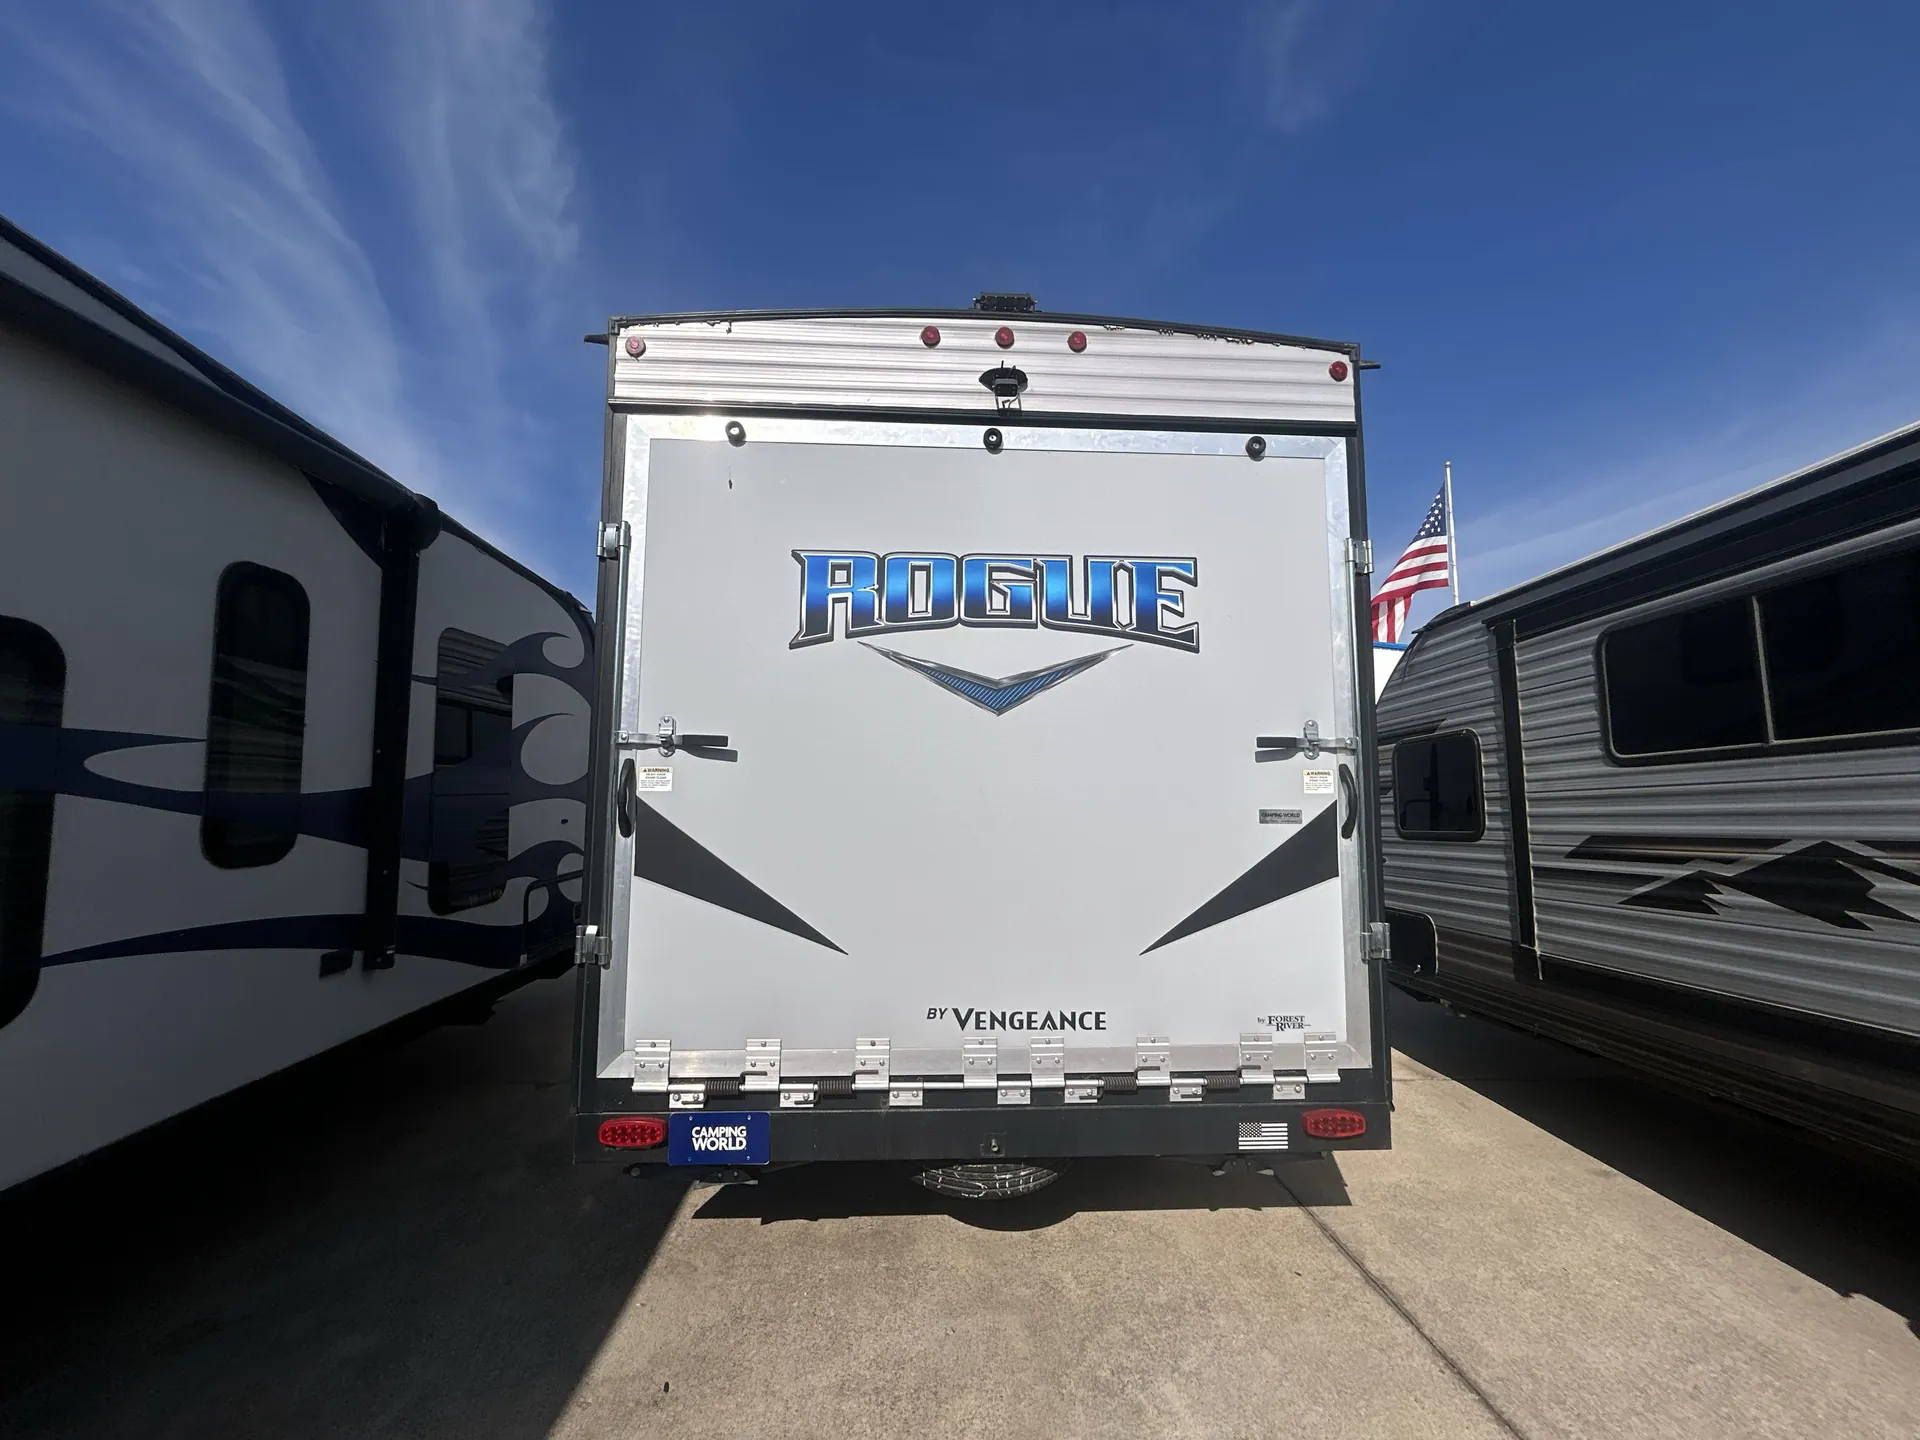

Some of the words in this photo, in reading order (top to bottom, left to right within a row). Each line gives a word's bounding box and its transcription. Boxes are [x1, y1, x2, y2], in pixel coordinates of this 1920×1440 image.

[789, 549, 1200, 653] ROGUE
[927, 1008, 948, 1020] BY
[952, 1008, 1107, 1031] VENGEANCE
[1268, 1015, 1305, 1025] FOREST
[1276, 1022, 1304, 1031] RIVER
[691, 1126, 747, 1138] CAMPING
[692, 1137, 747, 1151] WORLD
